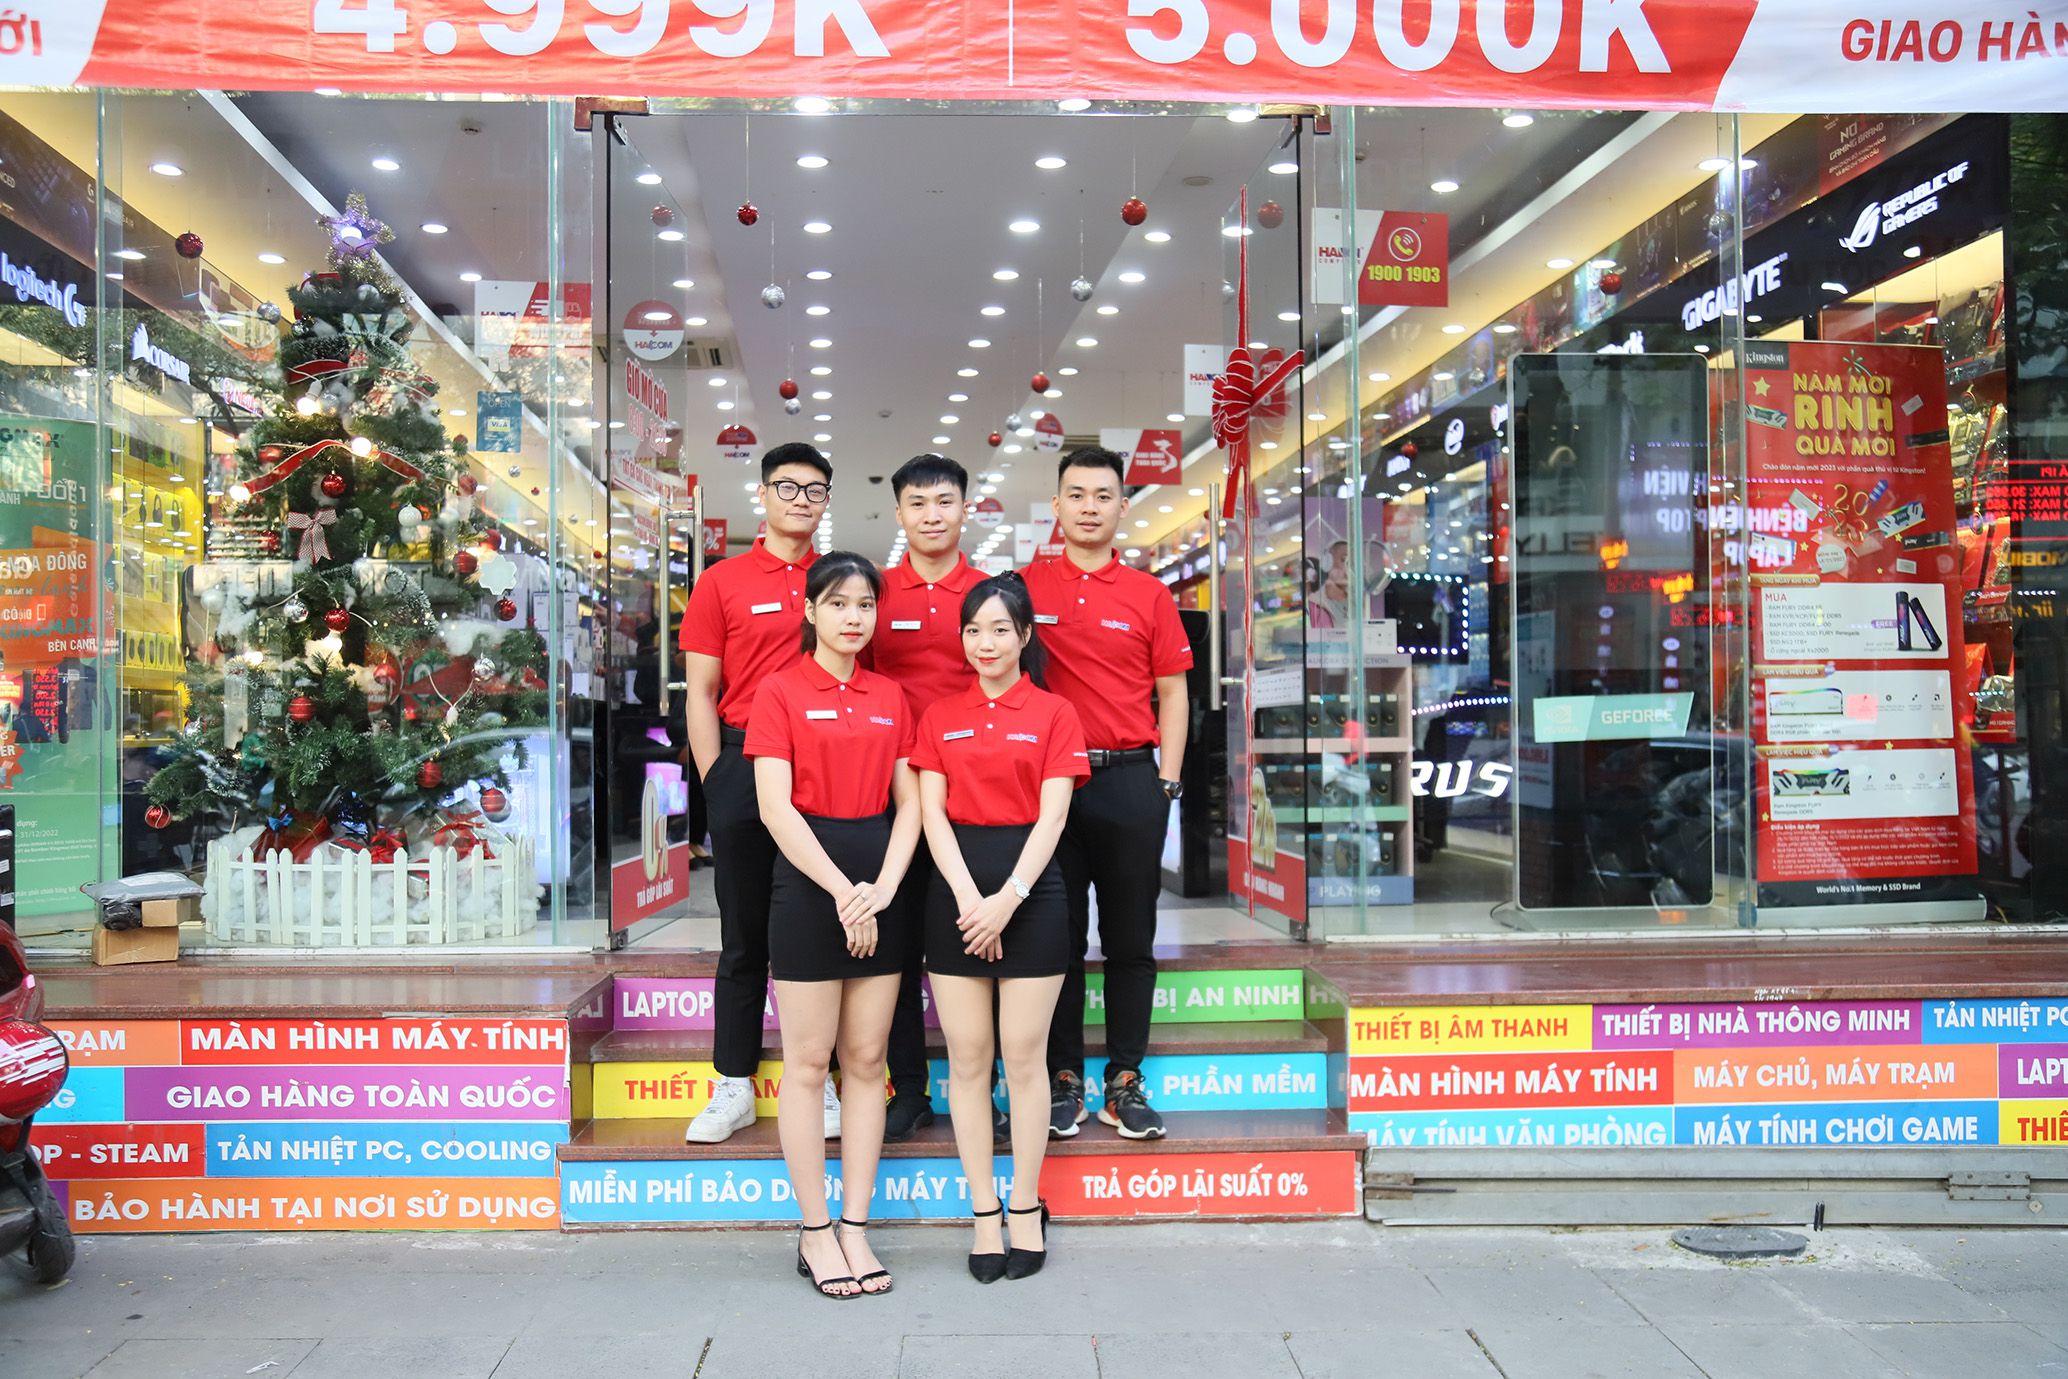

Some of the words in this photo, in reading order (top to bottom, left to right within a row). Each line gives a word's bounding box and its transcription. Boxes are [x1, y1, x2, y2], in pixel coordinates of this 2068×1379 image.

[1124, 0, 1671, 75] 5.000K
[1841, 19, 1962, 63] GIAO
[1882, 172, 1948, 217] REPUBLIC
[1947, 161, 1970, 184] OF
[1882, 196, 1939, 235] GAMERS
[1, 252, 64, 311] logitech
[1368, 265, 1402, 281] 1900
[1406, 266, 1440, 283] 1903
[1681, 256, 1783, 331] GIGABYTE
[1745, 351, 1785, 364] Kingston
[1793, 394, 1894, 433] RINH
[1762, 463, 1779, 471] Chào
[1899, 466, 1926, 475] Kingston!
[46, 552, 87, 571] ĐÔNG
[1765, 593, 1787, 602] MUA
[48, 639, 67, 652] BÊN
[70, 638, 96, 652] CẠNH
[1602, 708, 1674, 725] GEFORCE
[20, 829, 59, 839] 31/12/2022
[1816, 885, 1840, 895] World's
[1840, 884, 1855, 893] No.1
[1856, 884, 1882, 895] Memory
[1889, 883, 1901, 891] SSD
[1902, 882, 1921, 891] Brand
[622, 991, 714, 1018] LAPTOP
[1152, 988, 1177, 1014] BỊ
[1186, 987, 1224, 1008] AN
[1233, 985, 1300, 1006] NINH
[1355, 1012, 1412, 1041] THIẾT
[1420, 1020, 1439, 1045] BỊ
[1449, 1014, 1483, 1039] ÂM
[1492, 1018, 1568, 1038] THANH
[1602, 1004, 1663, 1036] THIẾT
[1669, 1013, 1690, 1041] BỊ
[1698, 1006, 1749, 1034] NHÀ
[1756, 1005, 1841, 1033] THÔNG
[1848, 1009, 1910, 1032] MINH
[1934, 1001, 1975, 1028] TẢN
[1982, 1001, 2040, 1032] NHIỆT
[57, 1029, 126, 1057] RẠM
[191, 1021, 276, 1050] MÀN
[289, 1020, 379, 1050] HÌNH
[392, 1020, 472, 1050] MÁY
[482, 1020, 564, 1050] TÍNH
[625, 1070, 698, 1100] THIẾT
[1163, 1064, 1242, 1095] PHẦN
[1252, 1063, 1316, 1094] MỀM
[1351, 1066, 1420, 1098] MÀN
[1431, 1064, 1505, 1096] HÌNH
[1515, 1063, 1582, 1094] MÁY
[1590, 1061, 1657, 1093] TÍNH
[1694, 1059, 1749, 1088] MÁY
[1756, 1056, 1817, 1091] CHỦ,
[1826, 1057, 1881, 1085] MÁY
[1888, 1062, 1955, 1090] TRẠM
[166, 1085, 250, 1109] GIAO
[261, 1078, 355, 1108] HÀNG
[364, 1078, 449, 1108] TOÀN
[459, 1075, 557, 1108] QUỐC
[1424, 1118, 1487, 1147] TÍNH
[1496, 1117, 1556, 1146] VĂN
[1565, 1115, 1667, 1145] PHÒNG
[1694, 1113, 1752, 1145] MÁY
[1758, 1112, 1817, 1144] TÍNH
[1825, 1114, 1894, 1143] CHƠI
[1902, 1116, 1978, 1142] GAME
[90, 1143, 189, 1164] STEAM
[218, 1133, 272, 1161] TẢN
[281, 1135, 358, 1166] NHIỆT
[366, 1140, 412, 1164] PC,
[420, 1140, 552, 1161] COOLING
[569, 1168, 637, 1204] MIỄN
[647, 1172, 694, 1203] PHÍ
[702, 1170, 762, 1202] BẢO
[885, 1170, 948, 1200] MÁY
[1083, 1166, 1122, 1199] TRẢ
[1128, 1168, 1177, 1198] GÓP
[1183, 1168, 1214, 1198] LÃI
[1220, 1162, 1272, 1197] SUẤT
[1278, 1172, 1308, 1197] 0%
[75, 1192, 150, 1221] BẢO
[161, 1192, 260, 1220] HÀNH
[271, 1197, 322, 1225] TẠI
[334, 1194, 396, 1219] NƠI
[406, 1189, 449, 1219] SỬ
[459, 1196, 557, 1225] DỤNG
